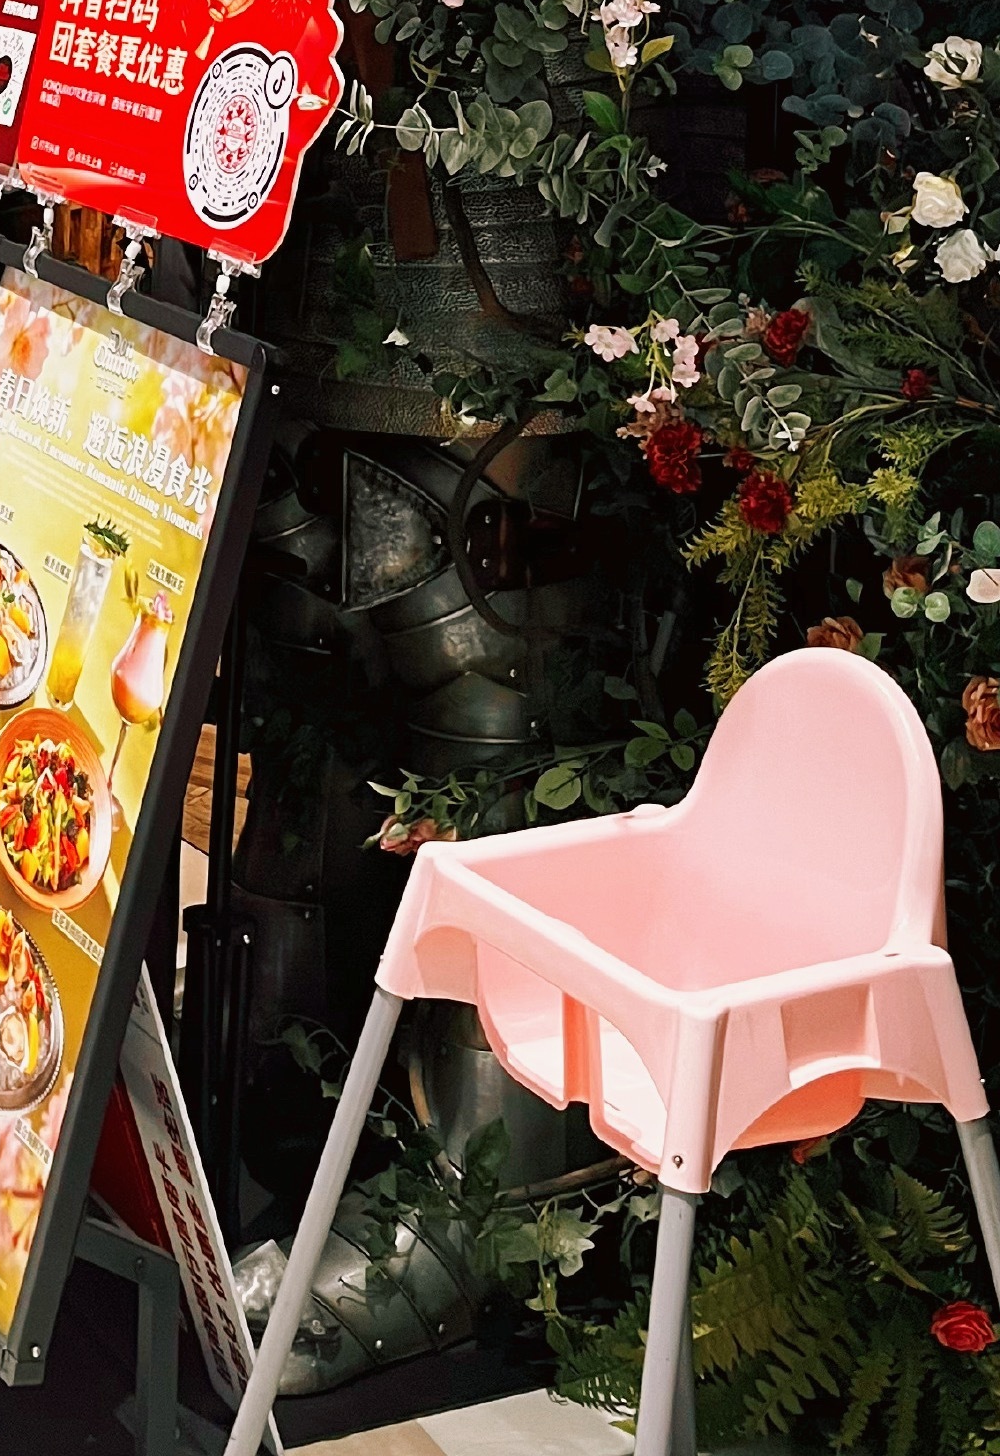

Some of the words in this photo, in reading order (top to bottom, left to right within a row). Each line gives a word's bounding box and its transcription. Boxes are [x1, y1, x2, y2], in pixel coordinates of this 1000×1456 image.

[49, 20, 188, 96] 团套餐更优惠
[43, 439, 87, 473] Encounter
[86, 460, 128, 498] Romantic
[128, 478, 160, 518] Dining
[161, 498, 203, 540] Moments
[82, 411, 213, 515] 邂逅浪漫食光
